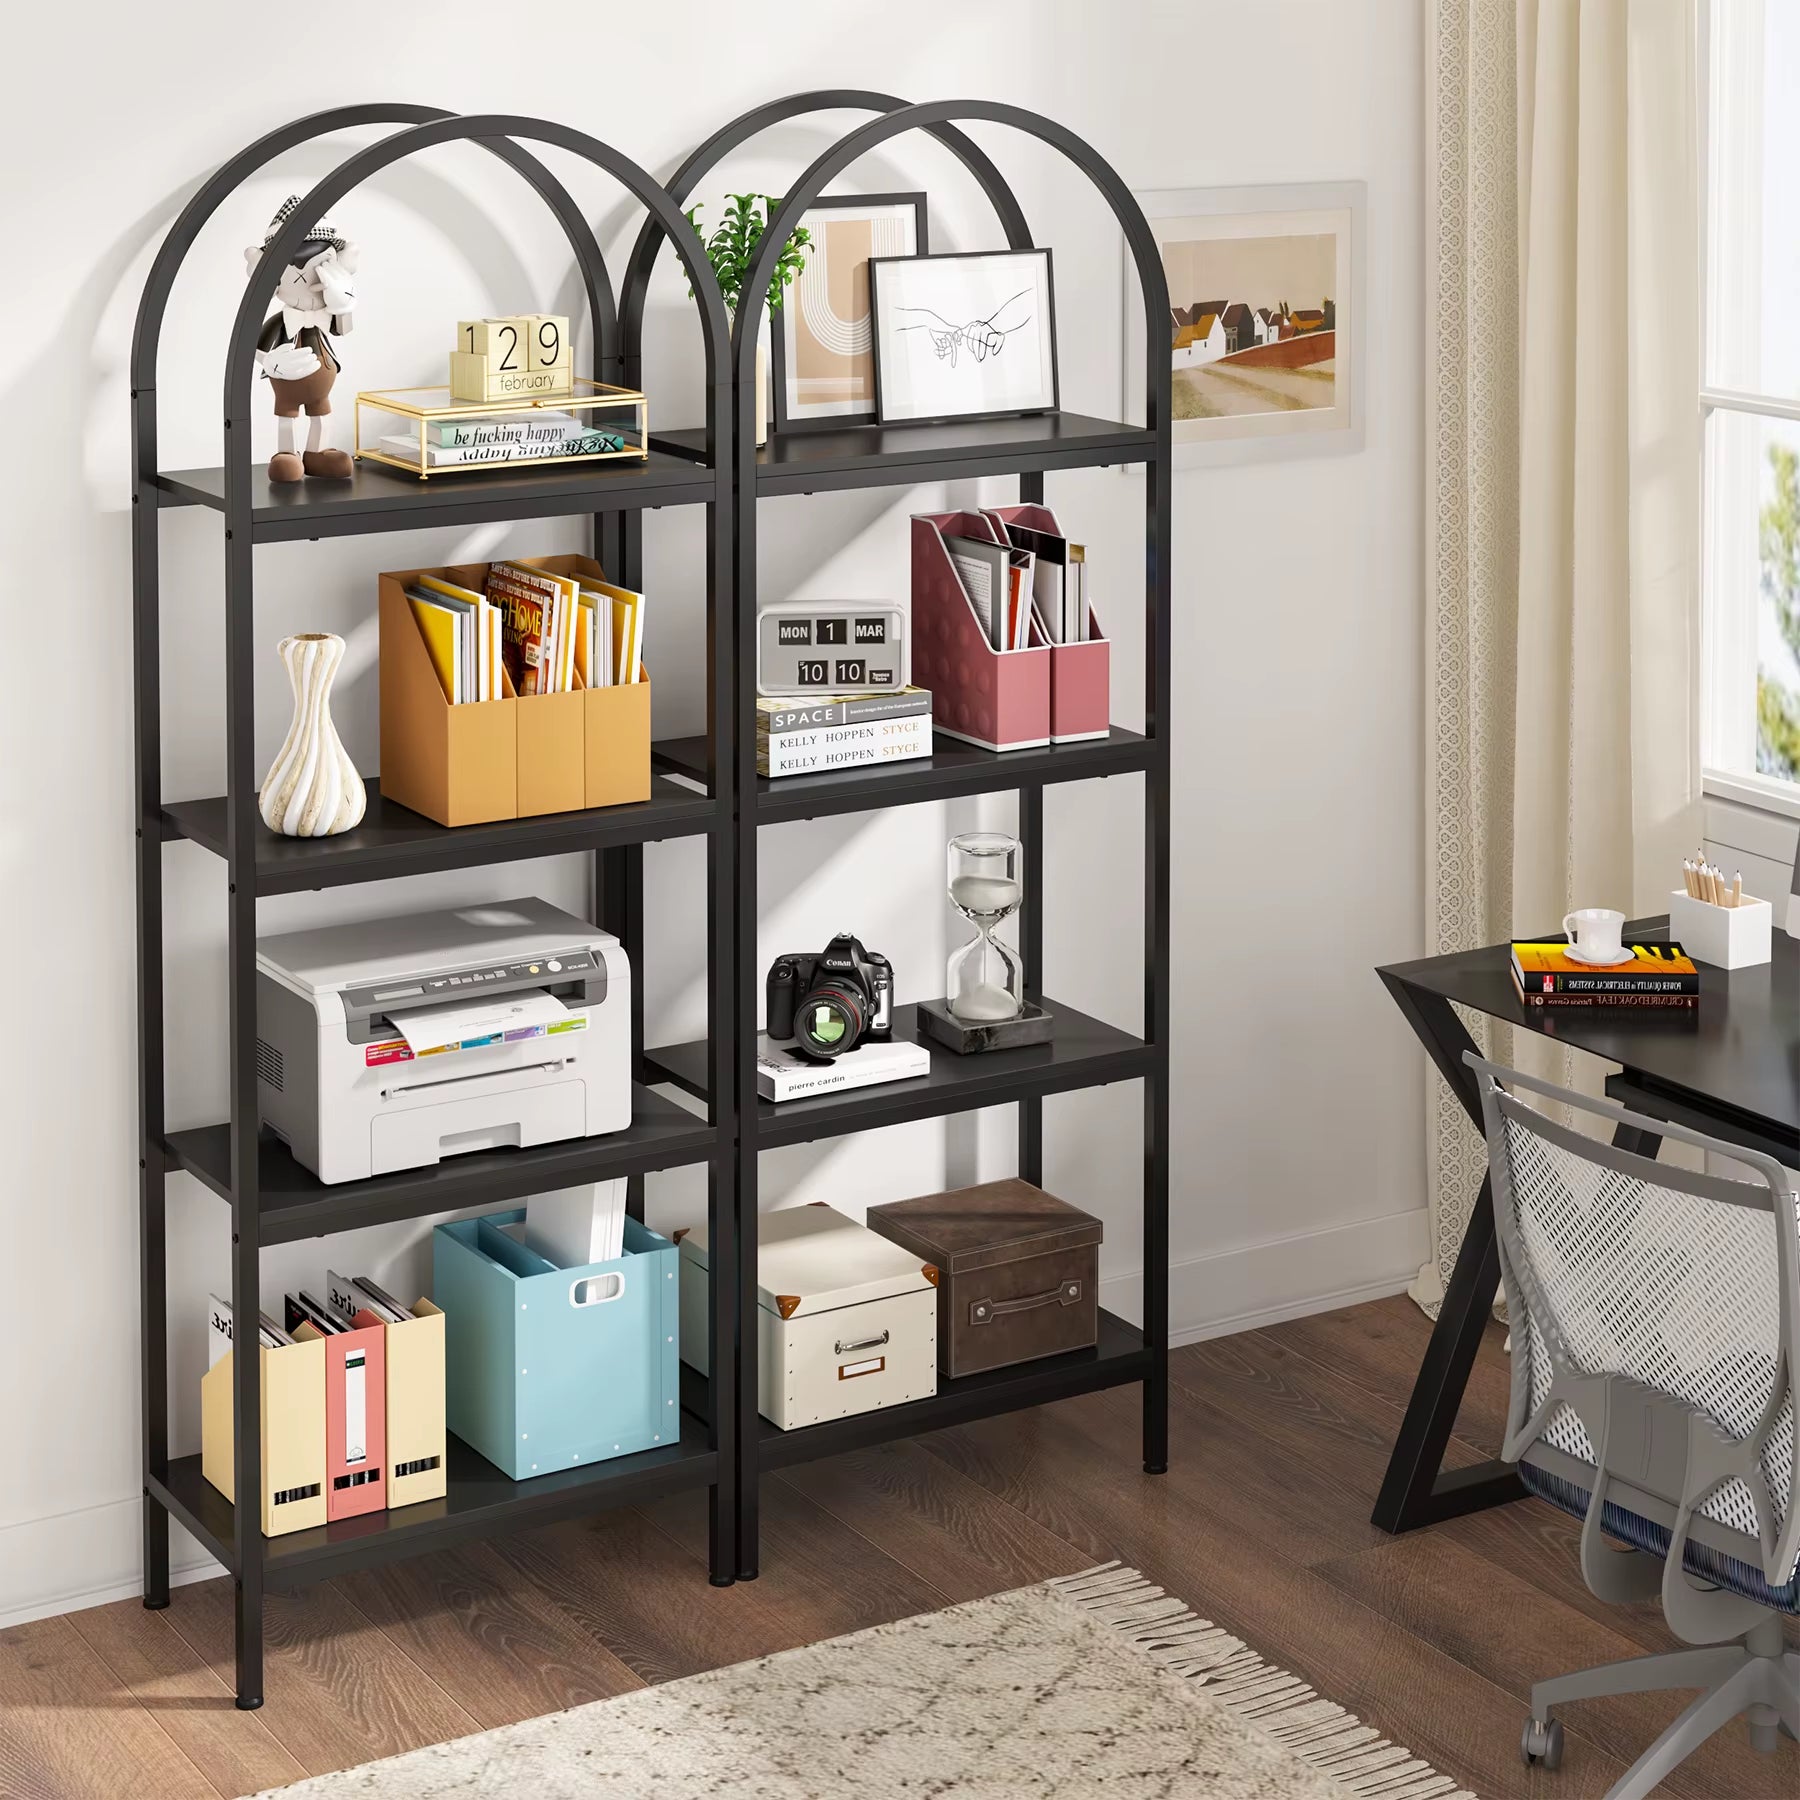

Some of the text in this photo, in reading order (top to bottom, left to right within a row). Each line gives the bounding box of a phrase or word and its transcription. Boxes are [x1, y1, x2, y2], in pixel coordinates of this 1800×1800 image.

[500, 374, 556, 392] february
[453, 423, 566, 448] be fucking happy
[459, 446, 512, 461] happy
[513, 570, 530, 584] BEFORE
[530, 576, 540, 588] YOU
[540, 578, 554, 593] BUILD
[506, 584, 522, 597] BEFORE
[522, 589, 531, 600] YOU
[531, 592, 543, 605] BUILD
[503, 627, 523, 646] IVING
[780, 622, 884, 641] MON 1 MAR
[801, 664, 823, 682] 10
[838, 663, 860, 681] 10
[775, 708, 834, 728] SPACE
[780, 735, 817, 749] KELLY
[826, 728, 875, 742] HOPPEN
[780, 756, 817, 770] KELLY
[826, 749, 875, 764] HOPPEN
[826, 958, 852, 967] Canon
[788, 1075, 845, 1093] pierre cardin
